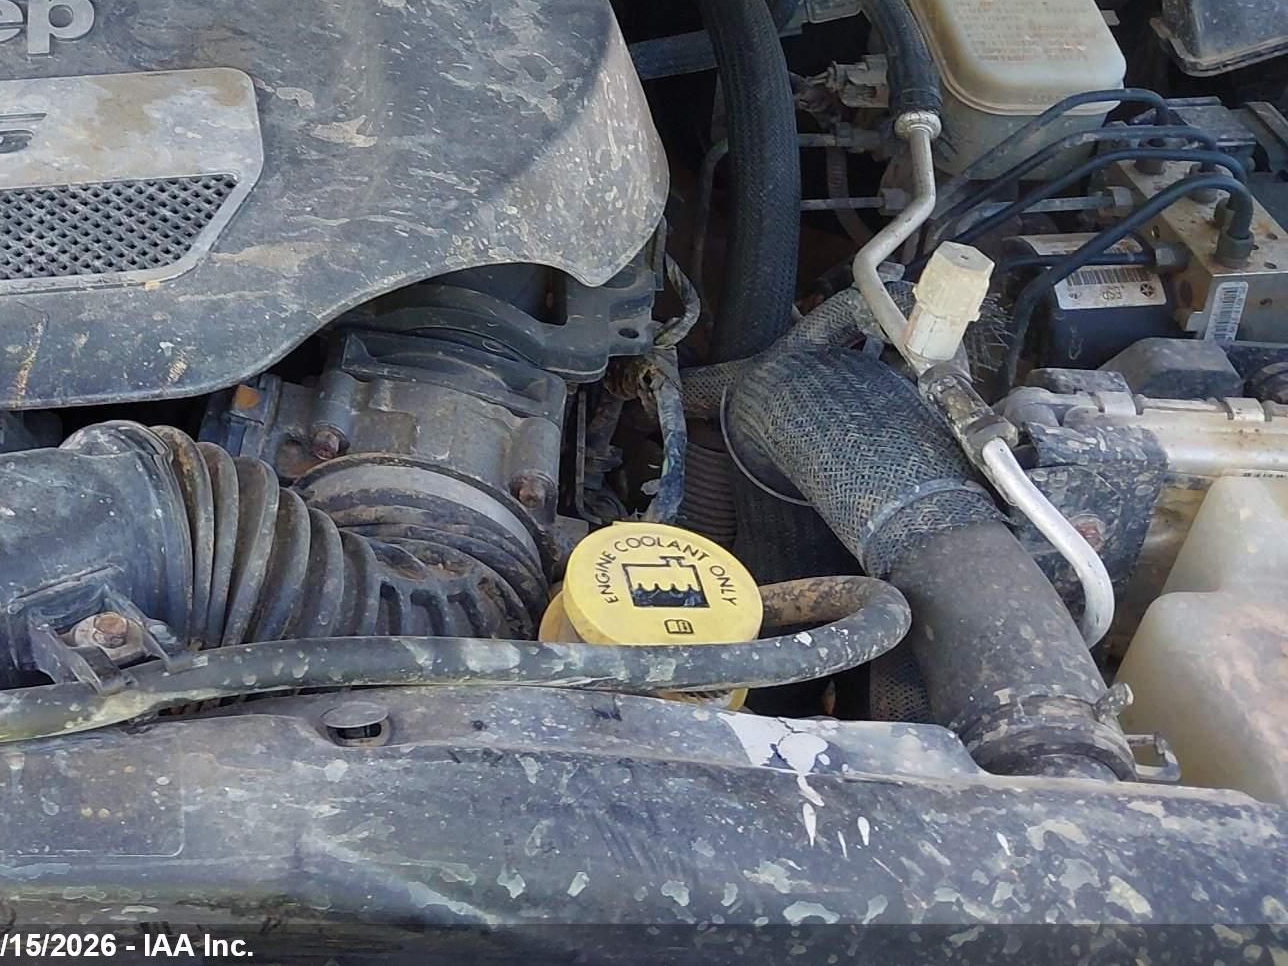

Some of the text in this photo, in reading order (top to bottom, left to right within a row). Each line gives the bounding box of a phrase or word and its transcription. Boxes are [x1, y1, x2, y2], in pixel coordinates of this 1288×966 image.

[595, 535, 737, 606] ENGINE COOLANT ONLY
